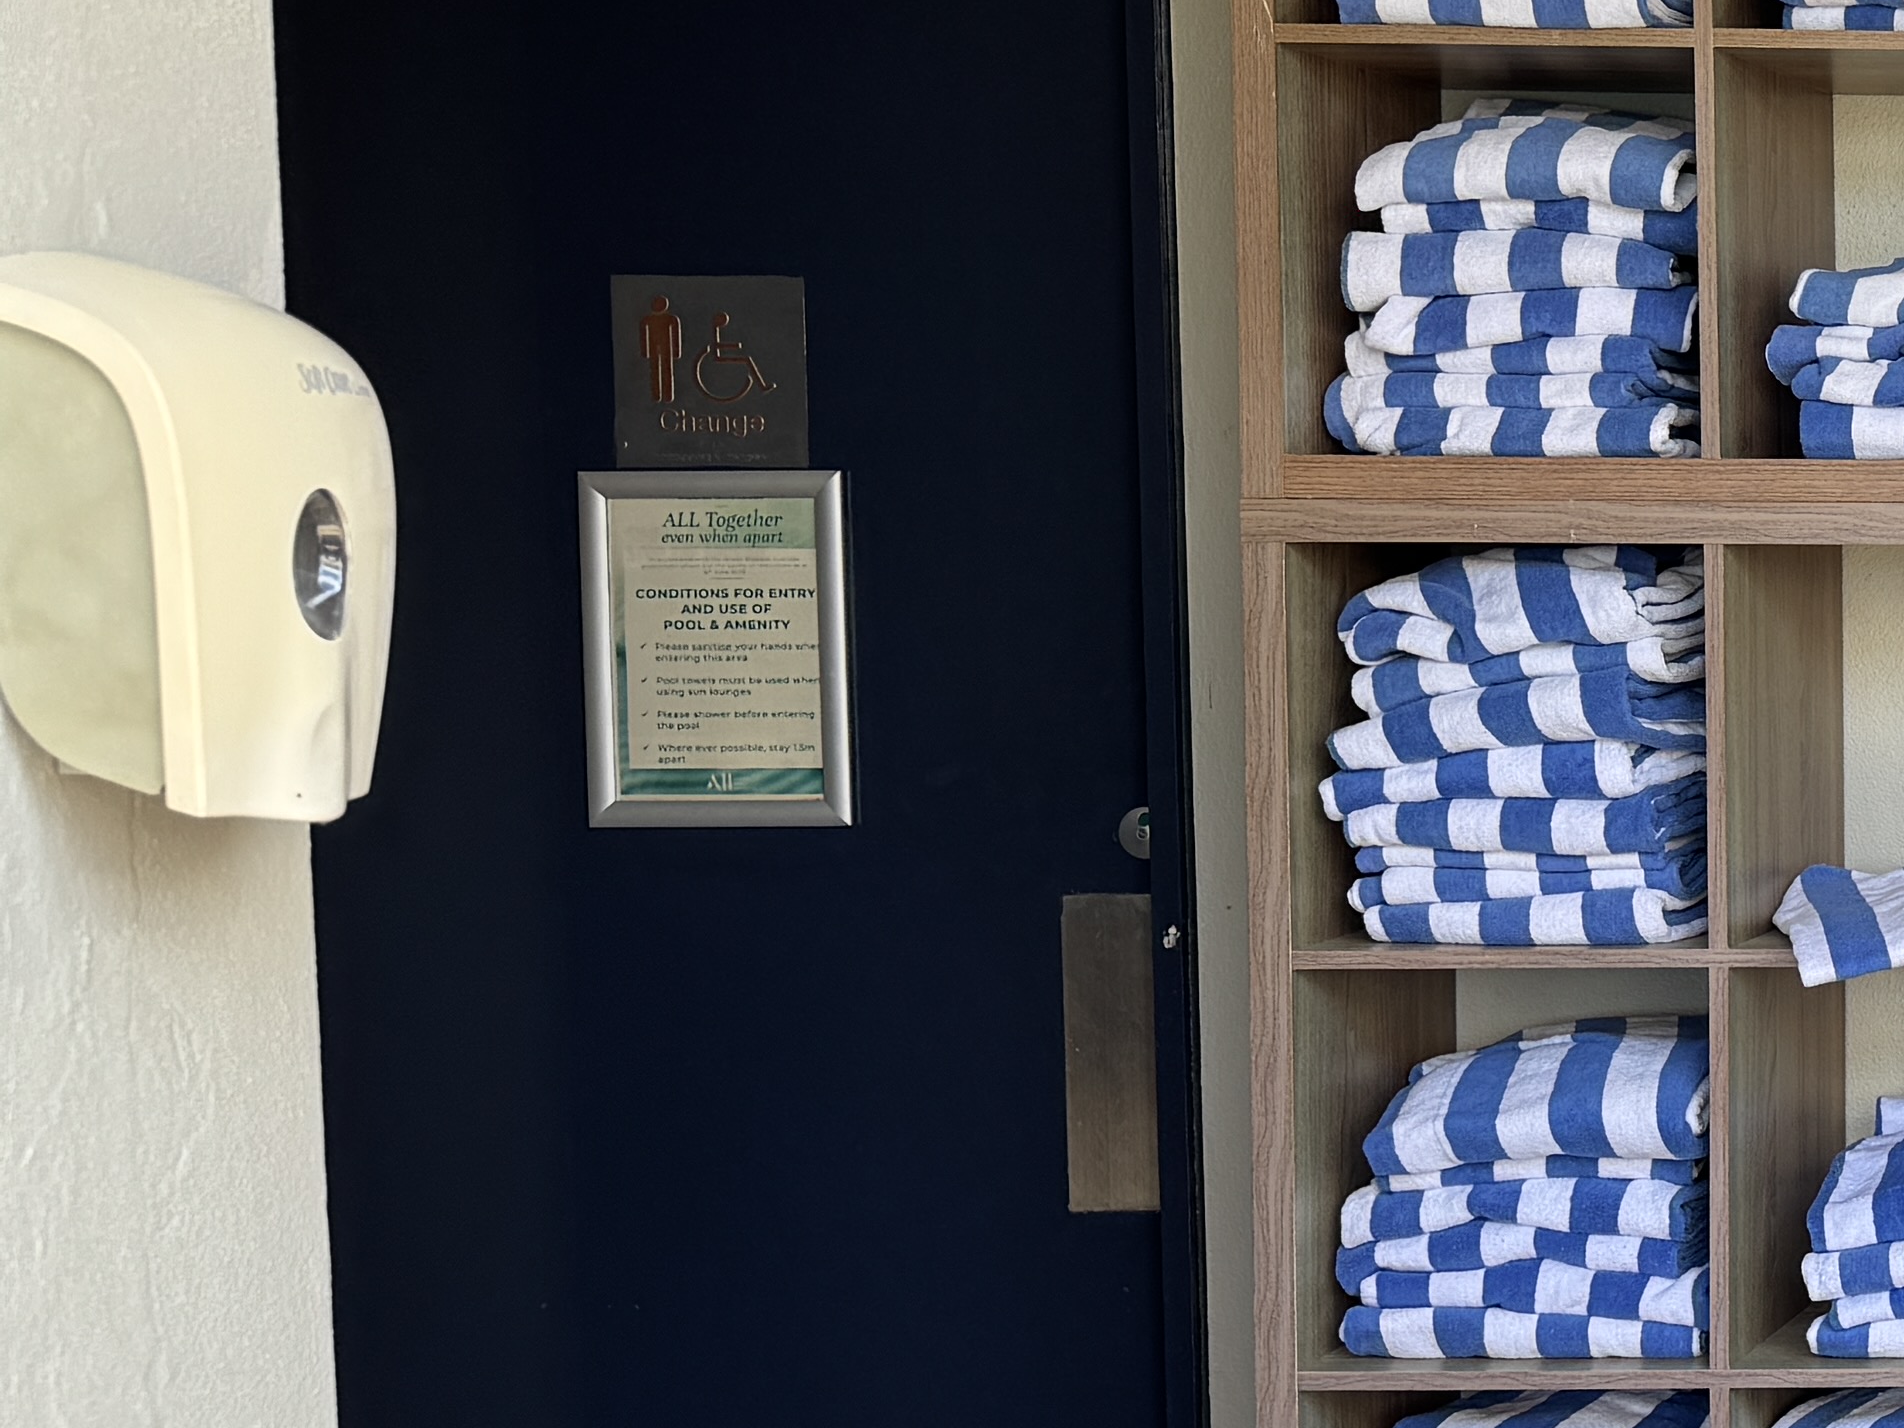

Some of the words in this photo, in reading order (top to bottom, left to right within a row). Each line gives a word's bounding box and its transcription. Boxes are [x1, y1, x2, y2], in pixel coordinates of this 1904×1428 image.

[660, 408, 765, 438] Change
[662, 511, 700, 528] ALL
[705, 508, 783, 532] Together
[661, 532, 694, 544] even
[699, 528, 739, 544] when
[743, 531, 783, 547] apart
[635, 588, 730, 600] CONDITIONS
[734, 588, 764, 599] FOR
[769, 588, 816, 599] ENTRY
[681, 604, 714, 614] AND
[719, 604, 747, 614] USE
[752, 604, 772, 614] OF
[664, 620, 706, 631] POOL
[709, 620, 719, 630] &
[724, 620, 791, 630] AMENITY
